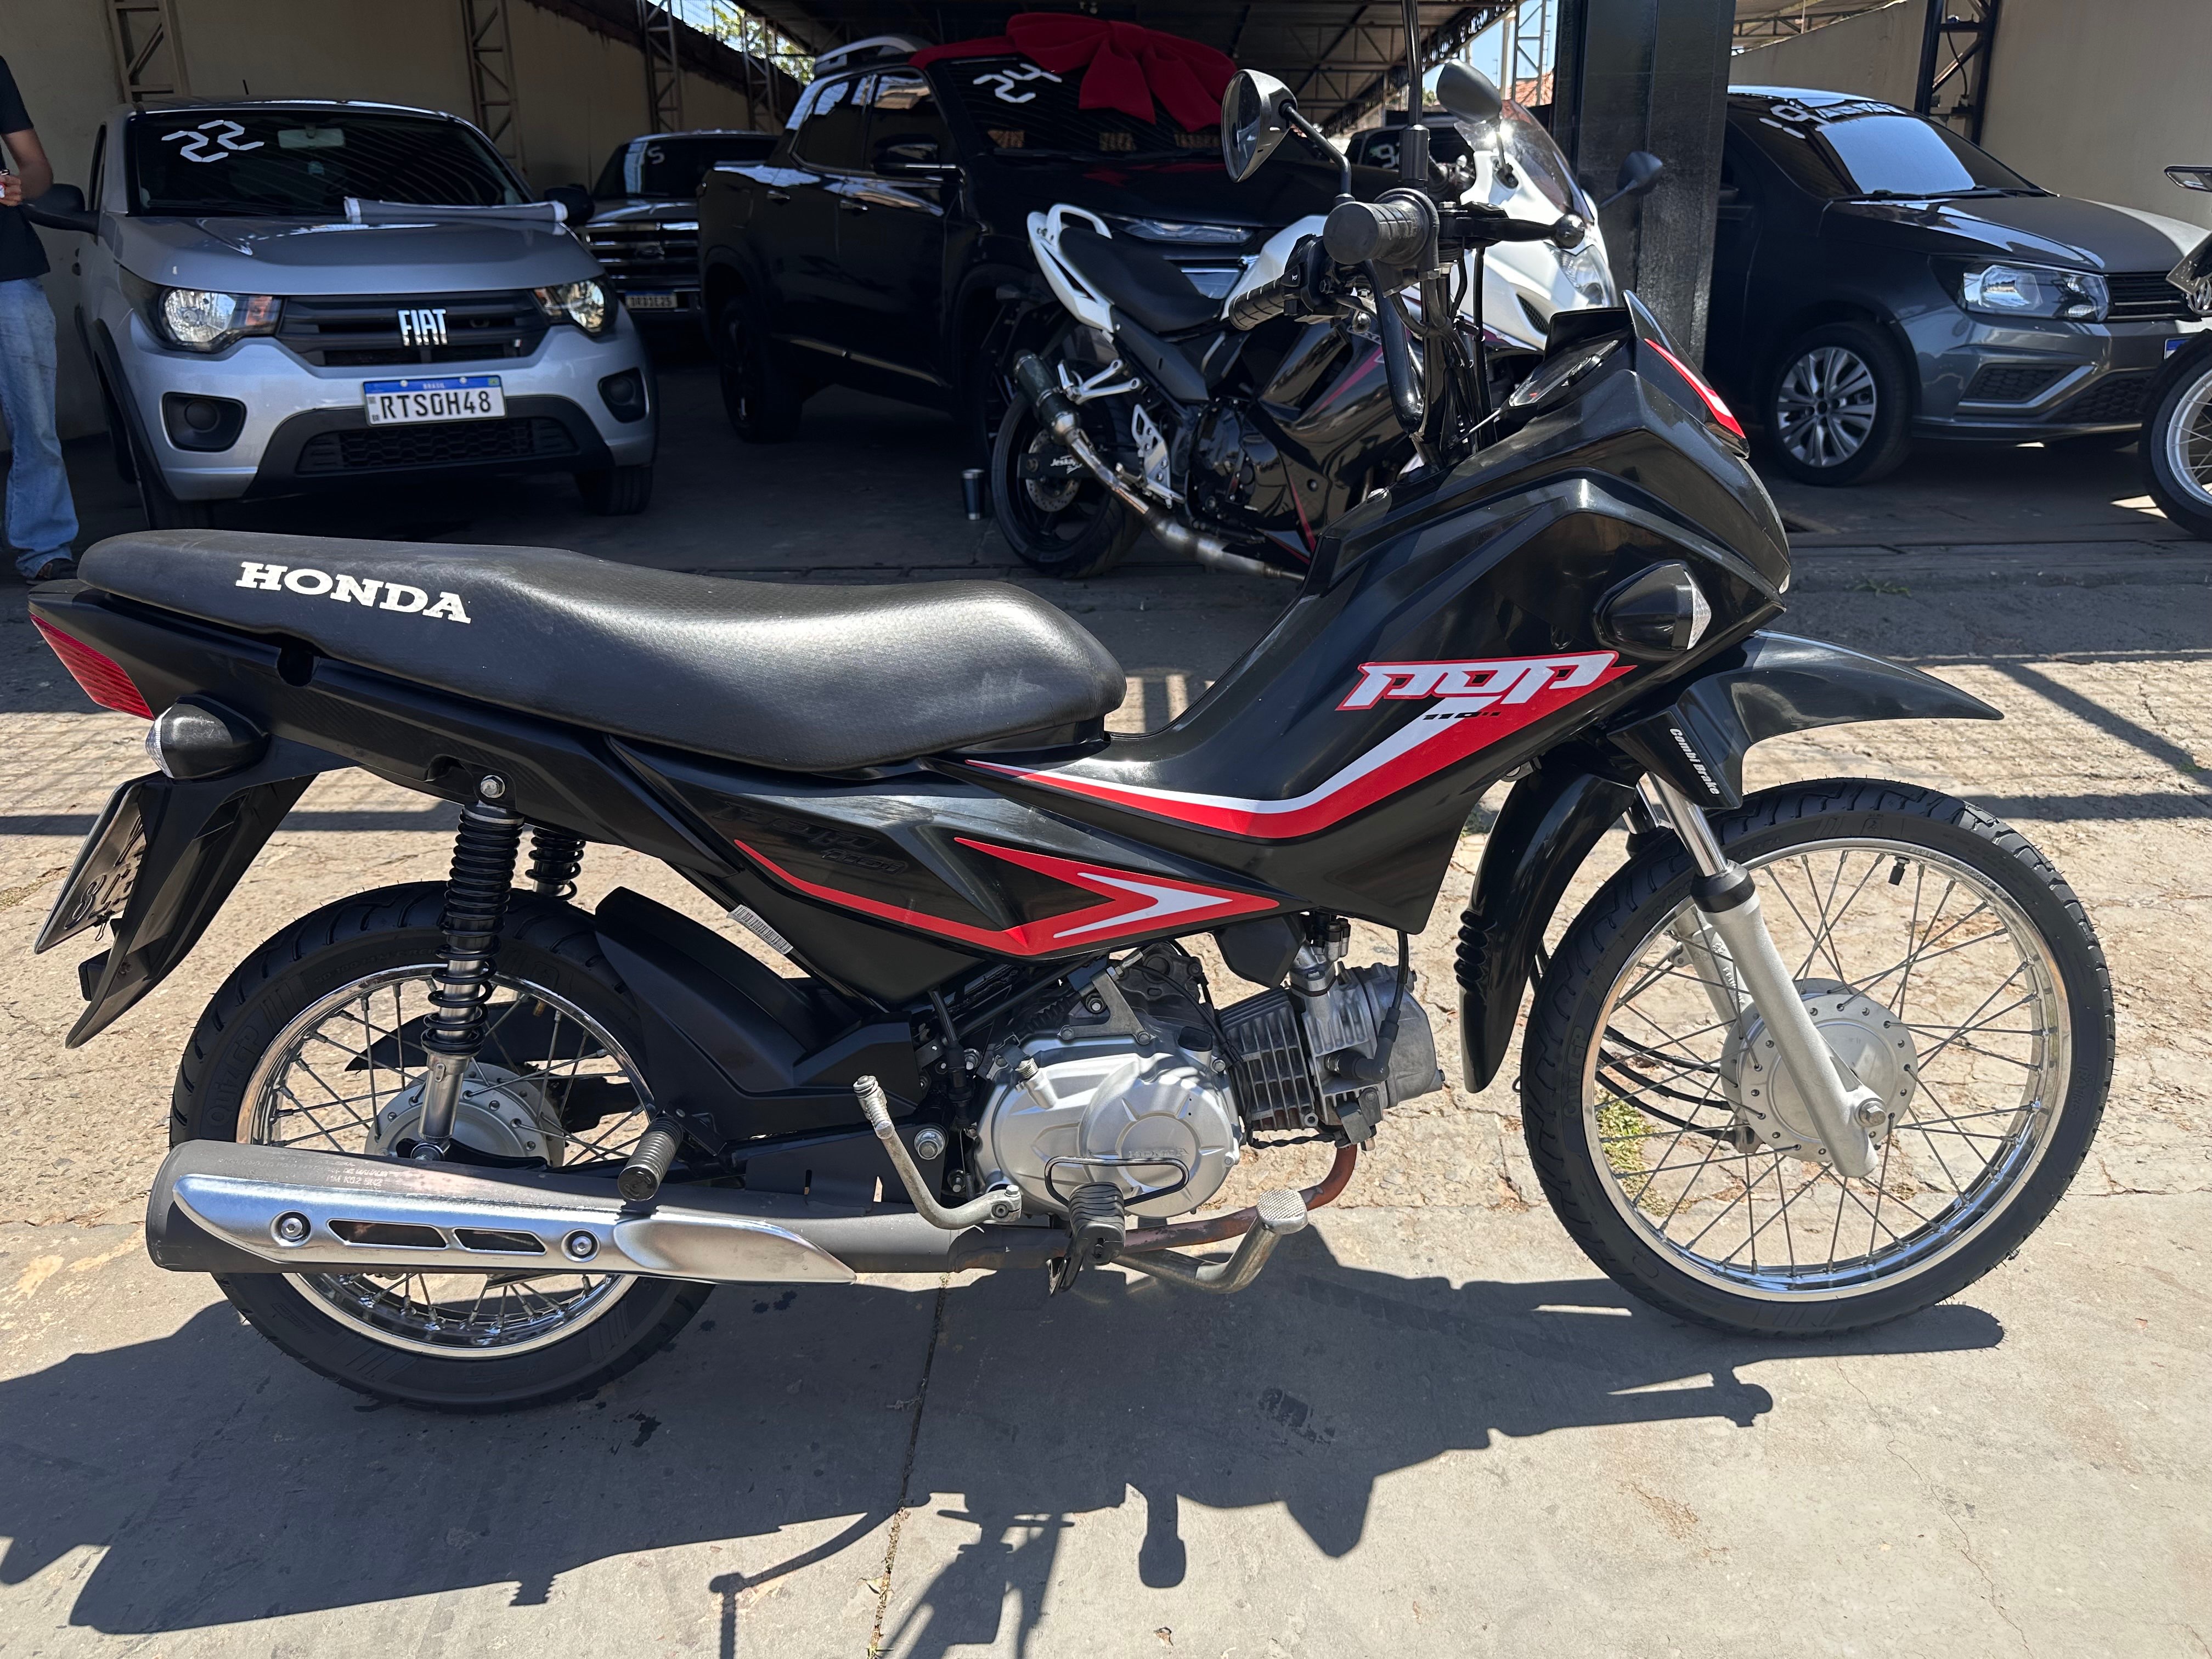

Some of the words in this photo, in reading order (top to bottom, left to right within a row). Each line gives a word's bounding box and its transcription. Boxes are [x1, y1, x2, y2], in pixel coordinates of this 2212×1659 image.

[972, 62, 1063, 103] 24
[161, 120, 265, 163] 22
[397, 308, 448, 347] FIAT
[235, 561, 471, 624] HONDA
[1669, 728, 1701, 763] Combi
[1692, 763, 1720, 795] Brake
